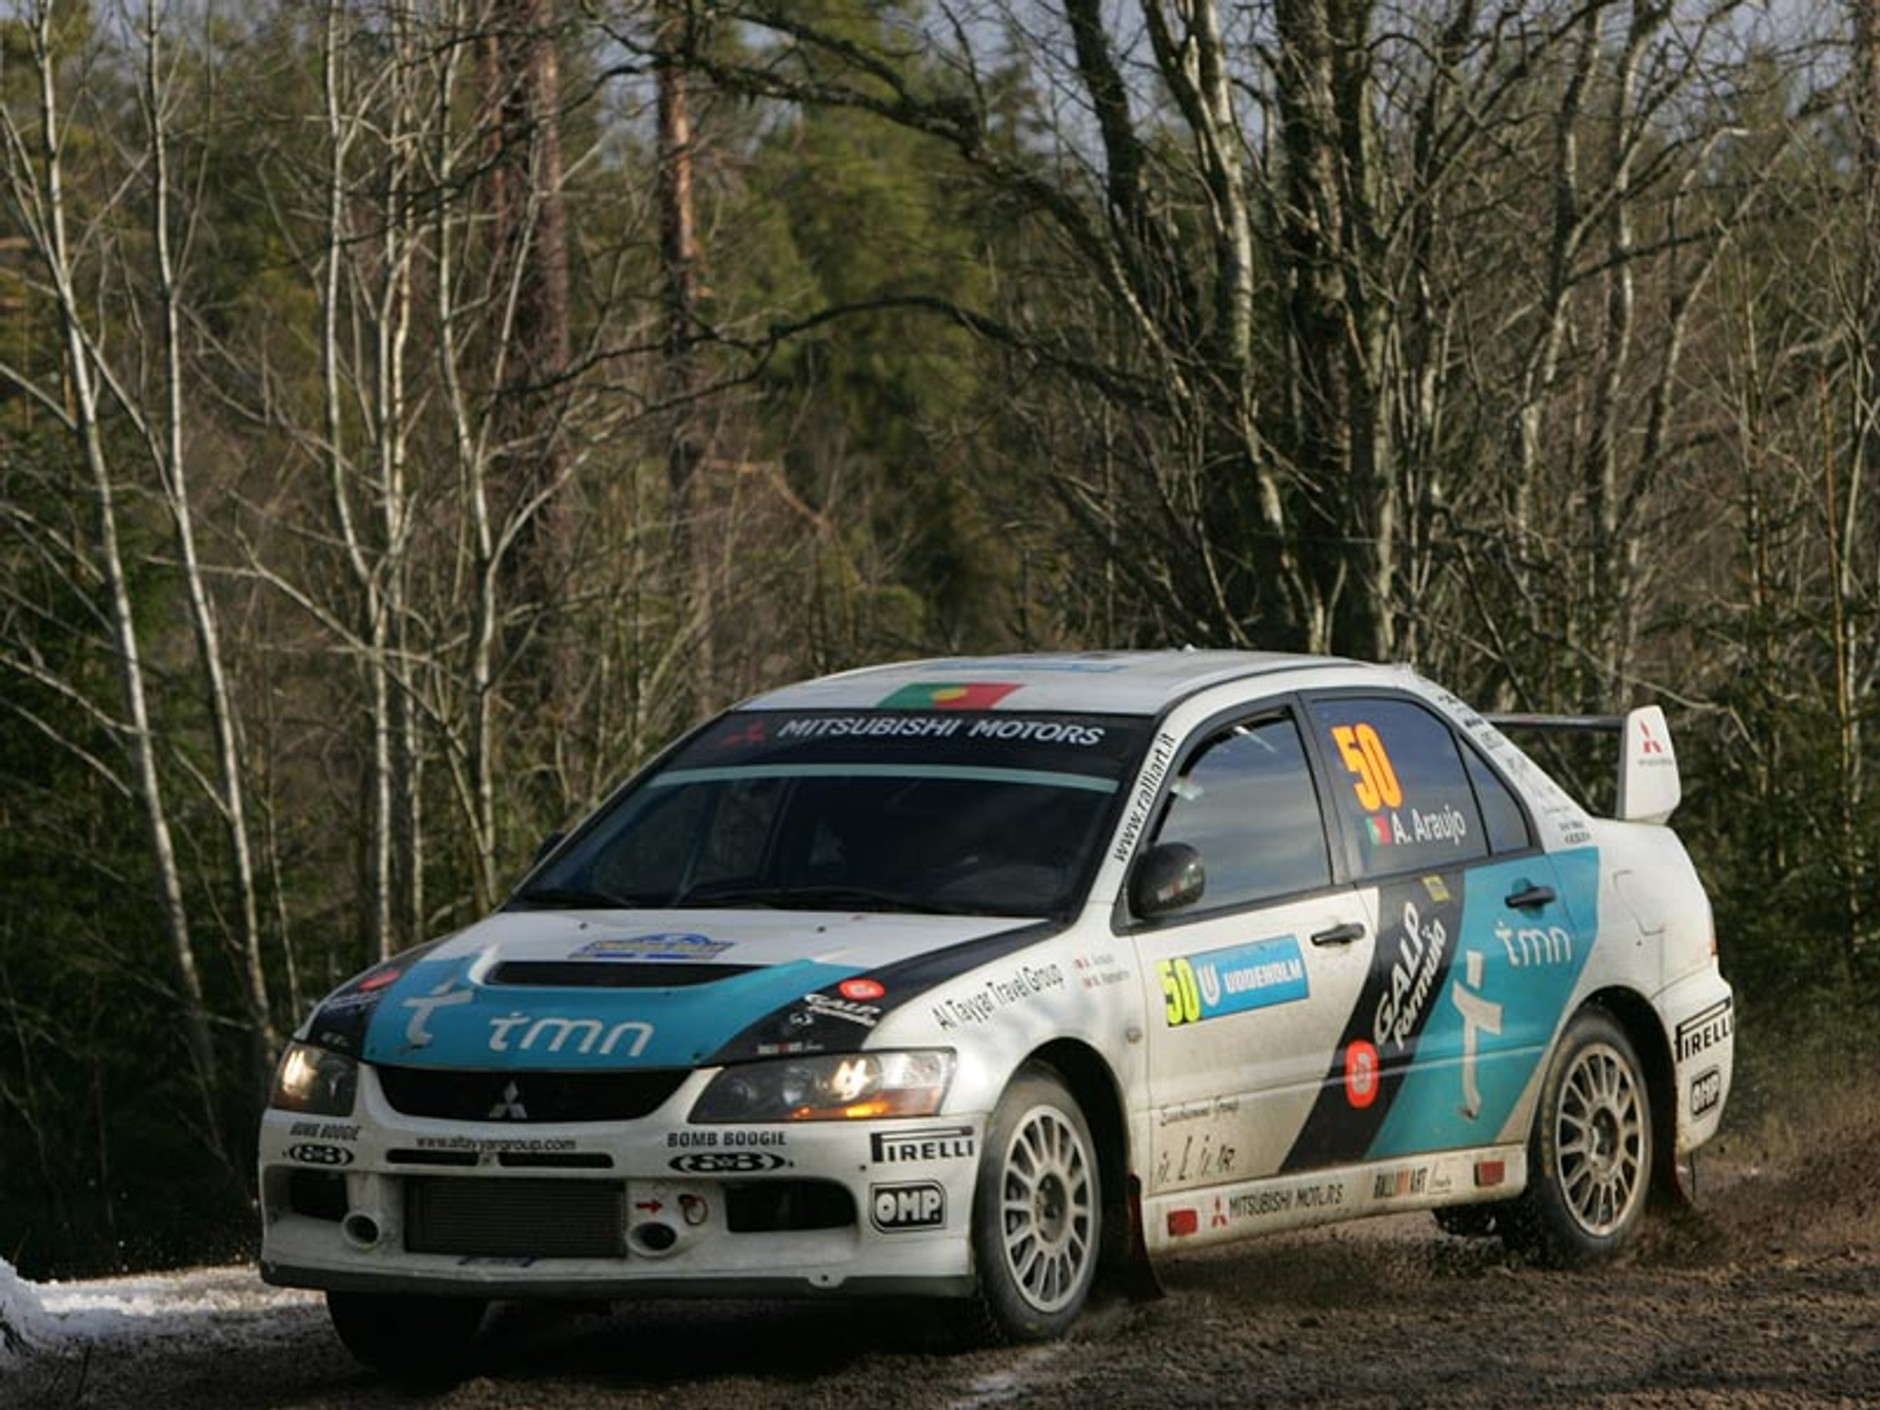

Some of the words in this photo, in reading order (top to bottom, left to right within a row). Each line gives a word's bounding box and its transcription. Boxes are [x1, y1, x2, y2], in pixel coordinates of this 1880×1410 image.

[778, 717, 960, 738] MITSUBISHI
[971, 720, 1105, 745] MOTORS
[1330, 722, 1403, 812] 50
[1114, 732, 1176, 862] www.ralliart.it
[1391, 811, 1413, 845] A.
[1494, 919, 1572, 967] tmn
[986, 969, 1030, 1005] Travel
[1155, 957, 1201, 1025] 50
[1374, 901, 1424, 1046] GALP
[488, 1011, 655, 1058] tmn
[1674, 996, 1735, 1063] PIRELLI
[667, 1132, 718, 1148] BOMB
[723, 1130, 787, 1146] BOOGIE
[870, 1126, 975, 1163] PIRELLI
[873, 1186, 942, 1226] OMP
[1229, 1190, 1292, 1218] MITSUBISHI
